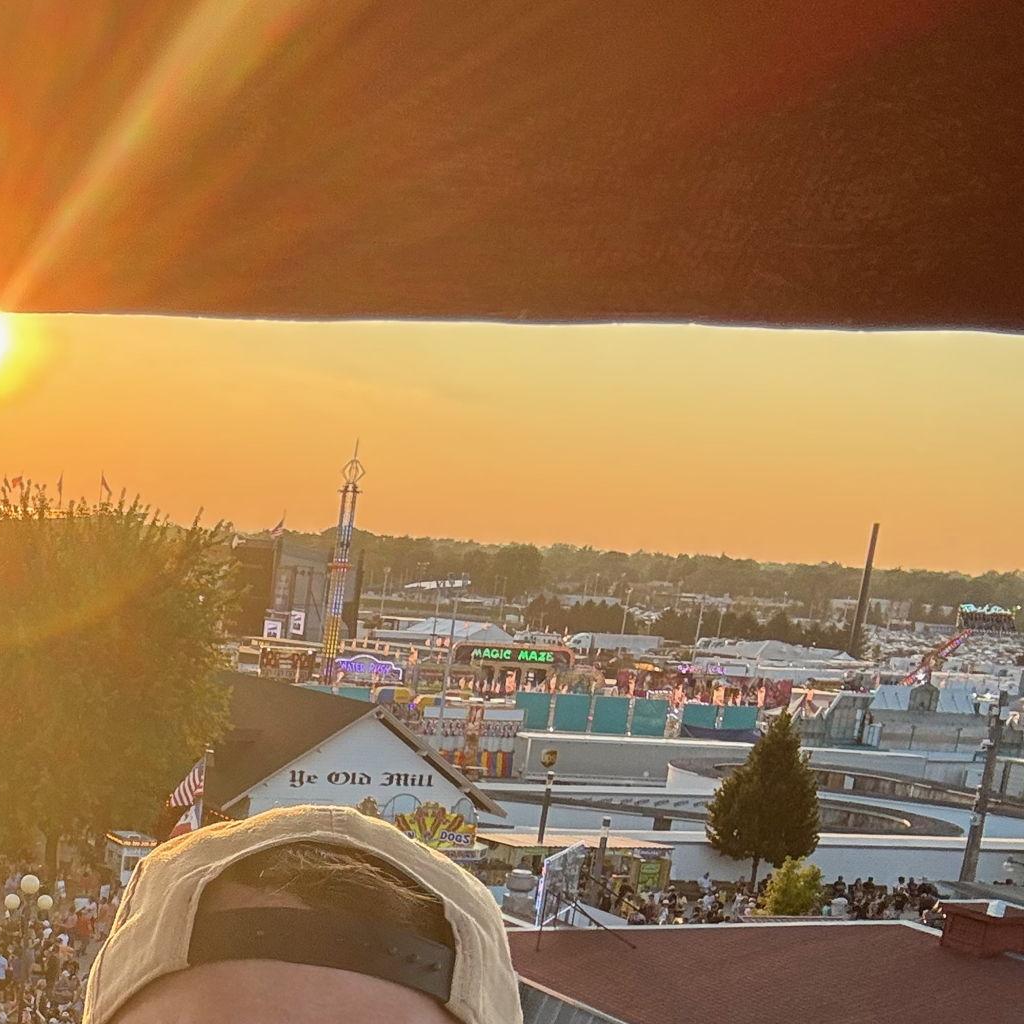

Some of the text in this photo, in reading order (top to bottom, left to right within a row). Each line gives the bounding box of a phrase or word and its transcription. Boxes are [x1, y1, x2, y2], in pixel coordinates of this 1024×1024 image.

[472, 648, 554, 662] MAGIC MAZE
[339, 660, 365, 673] WATER
[289, 770, 434, 788] Ye Old Mill
[440, 830, 471, 845] DOGS
